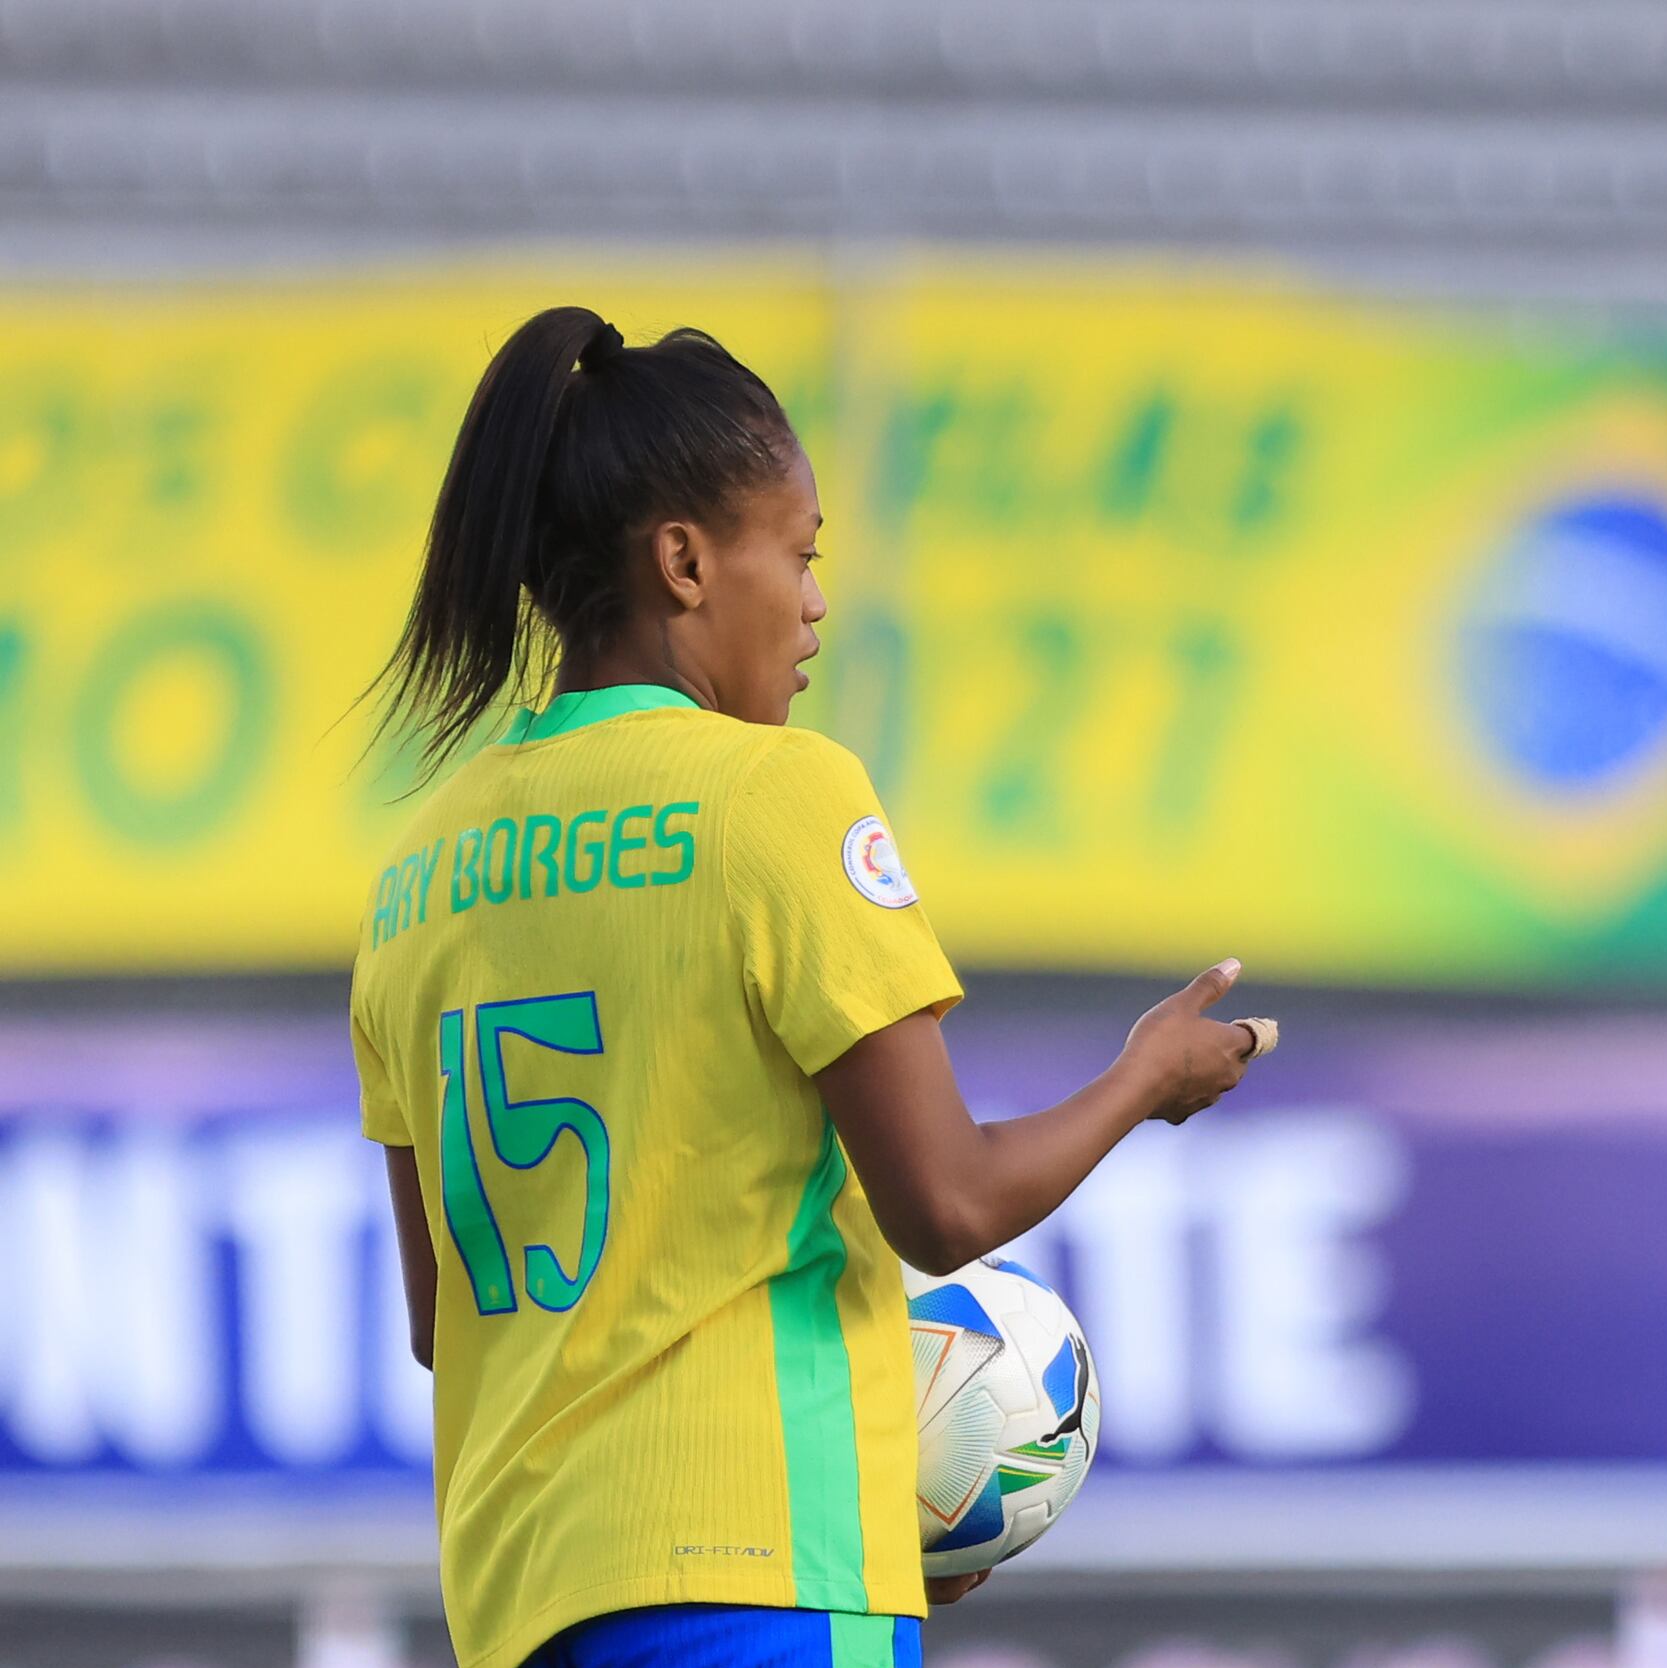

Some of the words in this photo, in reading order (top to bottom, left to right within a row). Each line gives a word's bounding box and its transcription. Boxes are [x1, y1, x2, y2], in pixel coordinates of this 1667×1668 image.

[372, 838, 445, 951] ARY
[451, 801, 699, 914] BORGES
[439, 990, 611, 1317] 15
